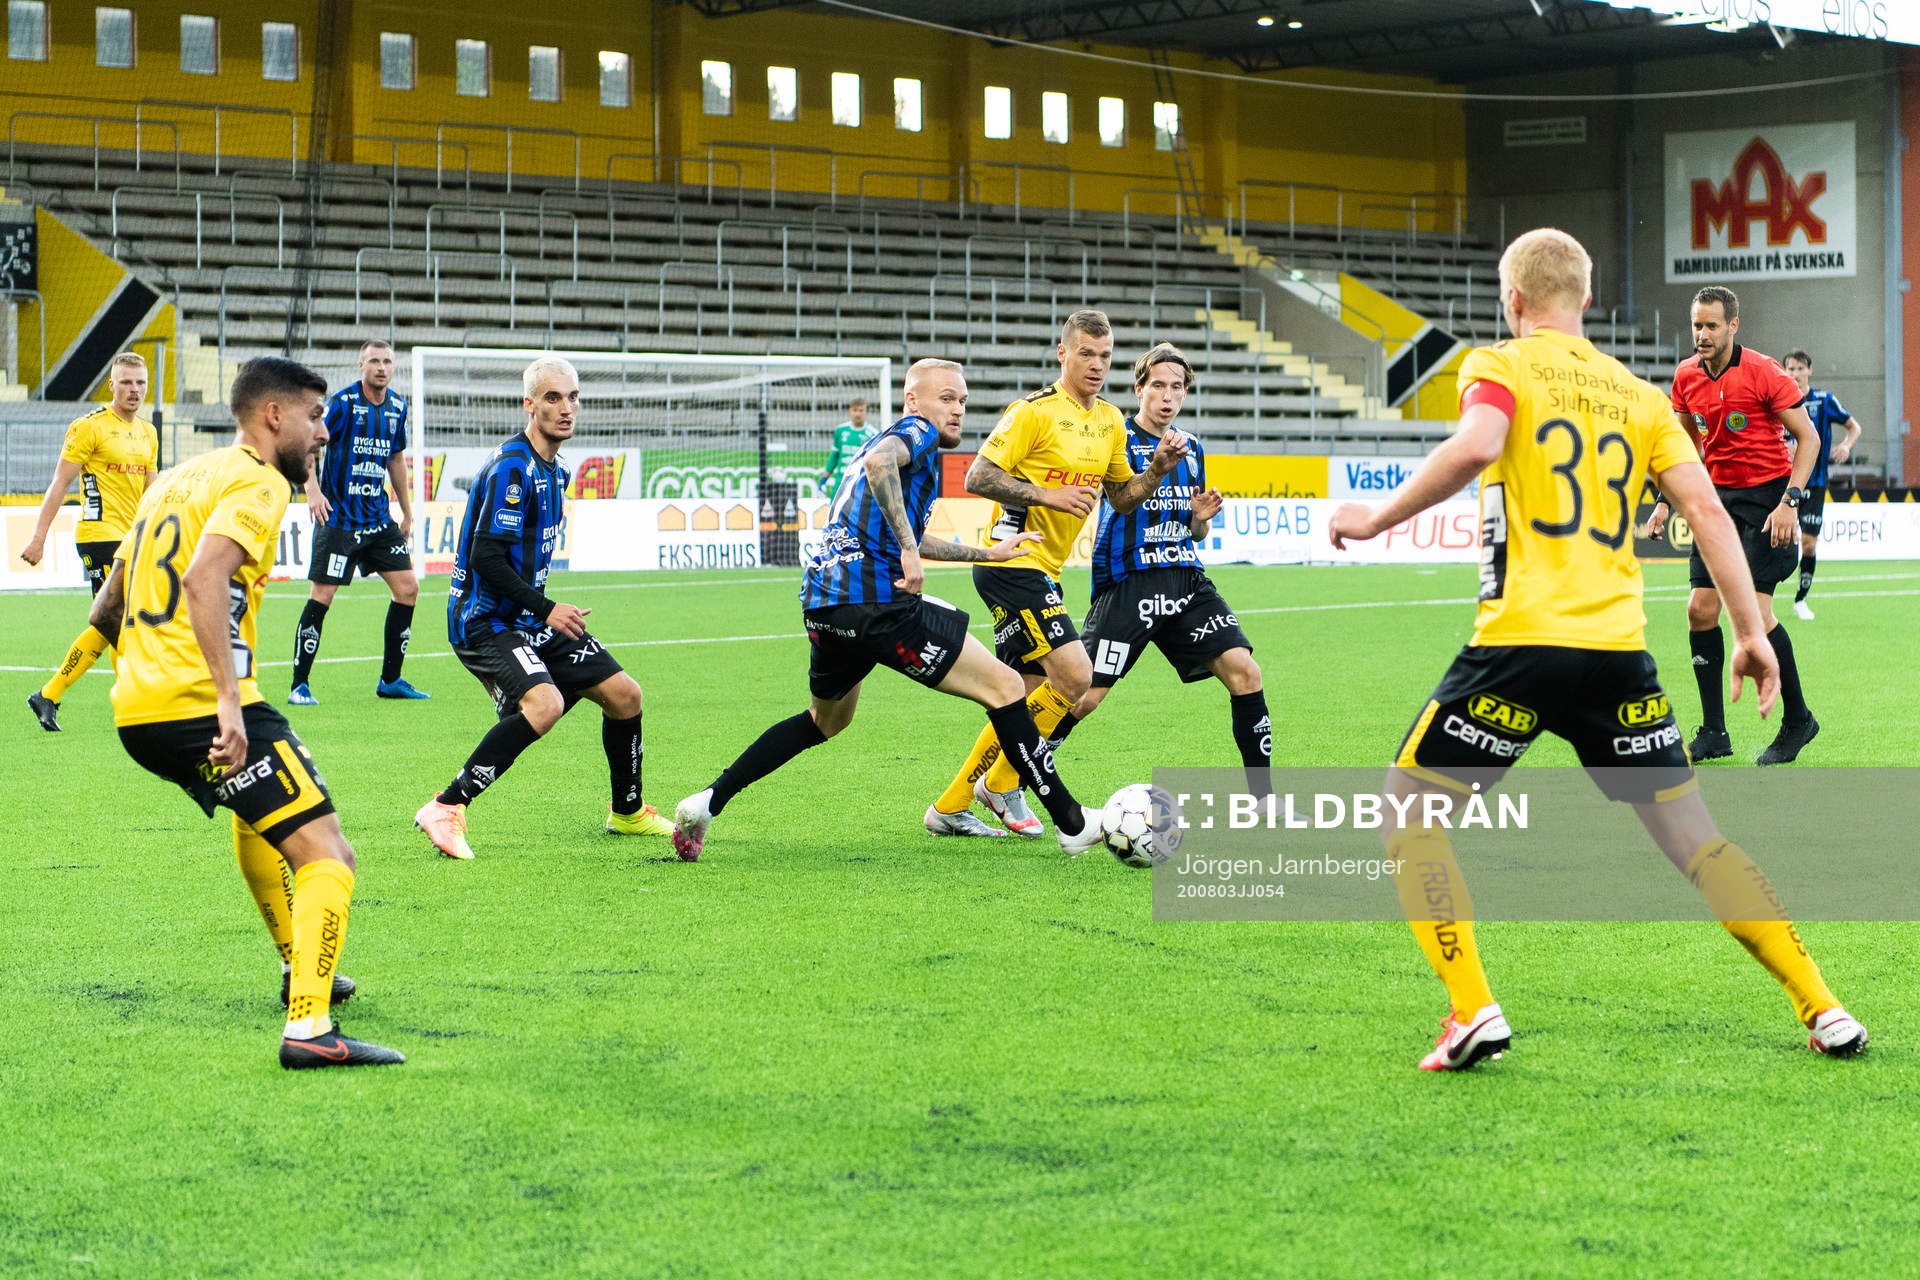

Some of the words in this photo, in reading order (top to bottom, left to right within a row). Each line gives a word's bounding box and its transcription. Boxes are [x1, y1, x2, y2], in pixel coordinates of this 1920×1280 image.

[1823, 0, 1888, 39] ellos
[1690, 135, 1827, 250] MAX
[1674, 255, 1762, 275] HAMBURGARE
[1766, 251, 1781, 270] PÅ
[1785, 252, 1845, 269] SVENSKA
[352, 445, 391, 457] CONSTRUCT
[353, 436, 374, 446] BYGG
[1044, 468, 1104, 489] PULSE
[1531, 418, 1633, 551] 33
[1143, 499, 1192, 511] CONSTRUC
[235, 511, 268, 536] UNIBET
[498, 514, 523, 523] UNIBET
[1234, 505, 1311, 535] UBAB
[1386, 513, 1481, 549] PULS
[1822, 520, 1882, 543] UPPEN
[1139, 545, 1196, 564] inkClub
[124, 513, 183, 629] 13
[1051, 621, 1064, 636] 8
[1473, 696, 1533, 730] EAB
[1018, 742, 1031, 762] Motor
[276, 769, 295, 795] umbro
[1416, 860, 1463, 962] FRISTADS
[317, 907, 341, 980] FRISTADS
